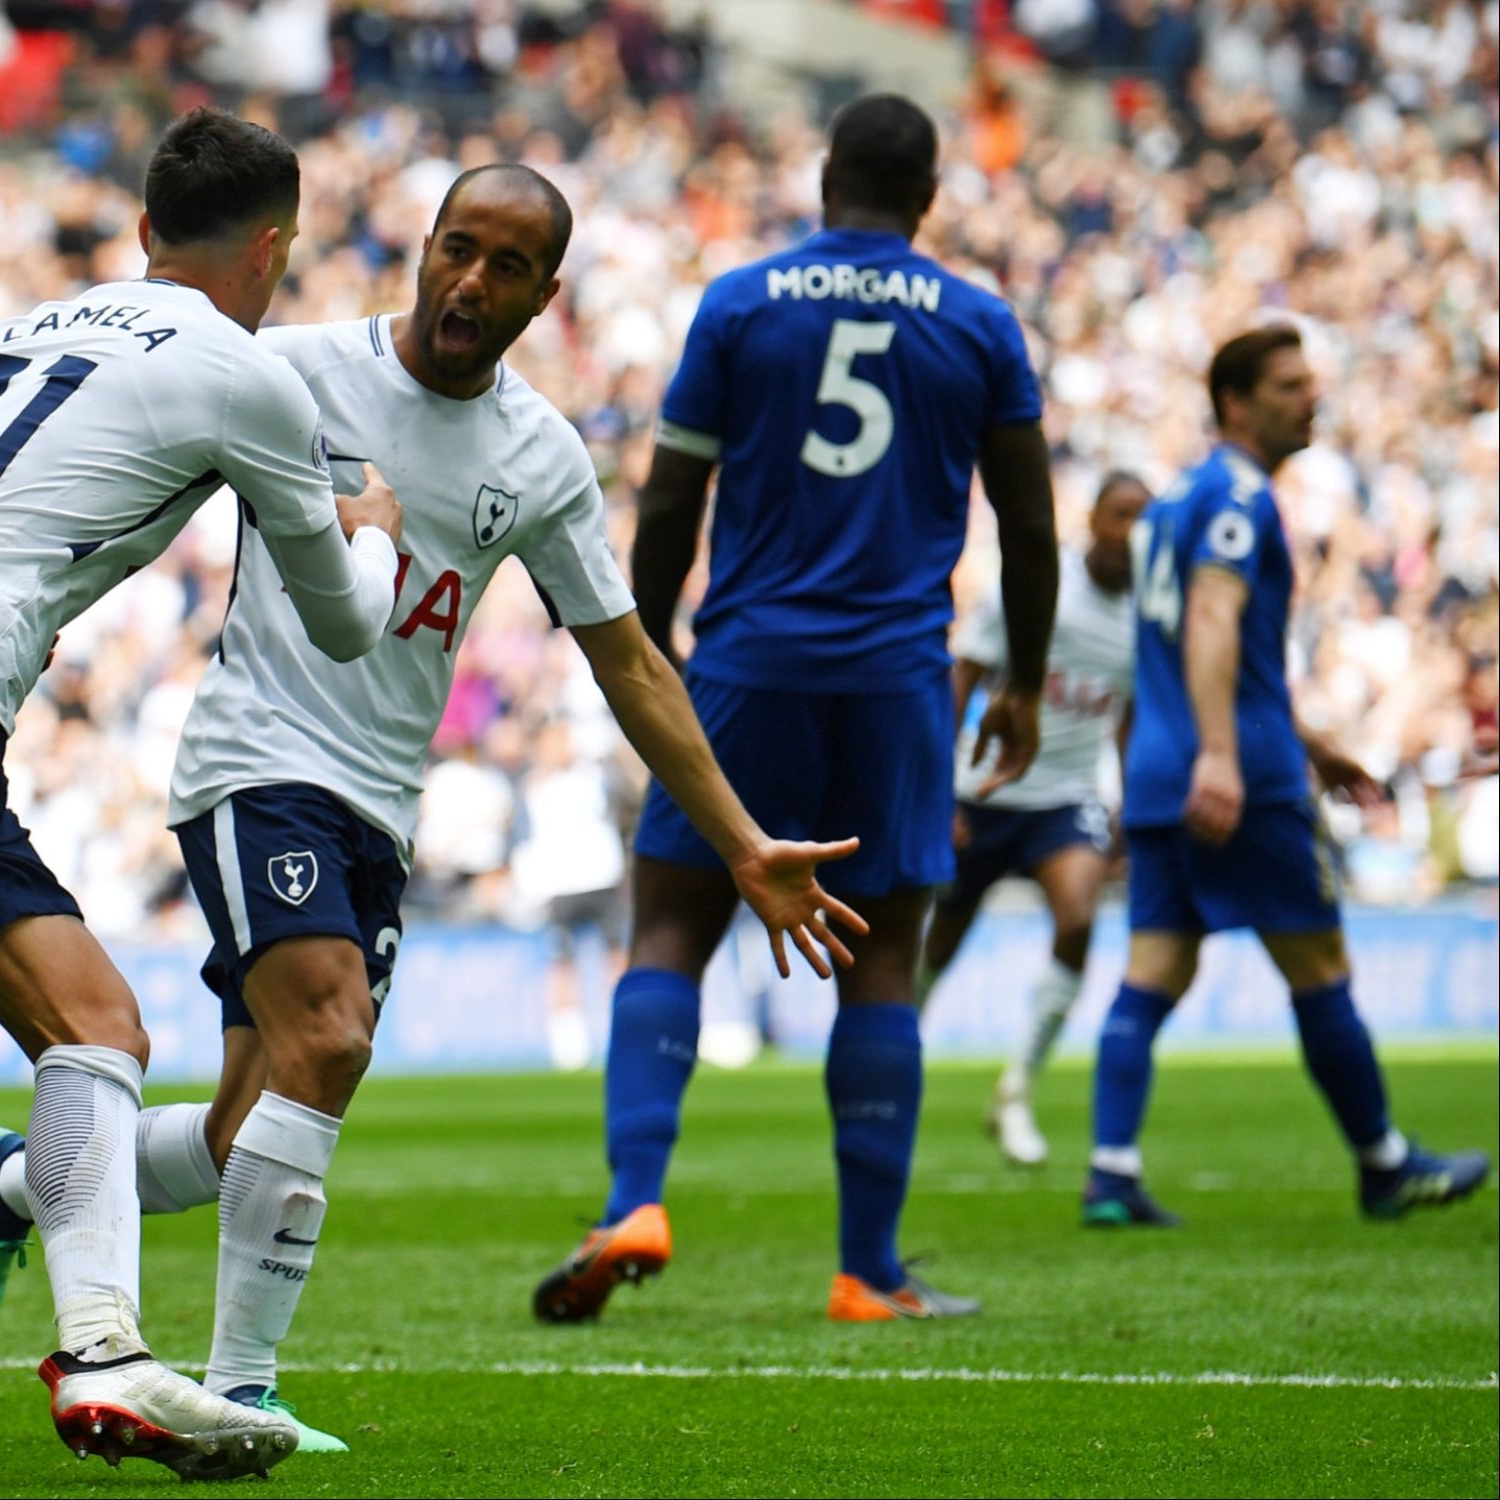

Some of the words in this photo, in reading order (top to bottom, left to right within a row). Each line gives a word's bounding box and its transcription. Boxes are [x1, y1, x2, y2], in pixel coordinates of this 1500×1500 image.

[766, 264, 942, 313] MORGAN
[2, 304, 178, 353] LAMELA
[800, 317, 897, 478] 5
